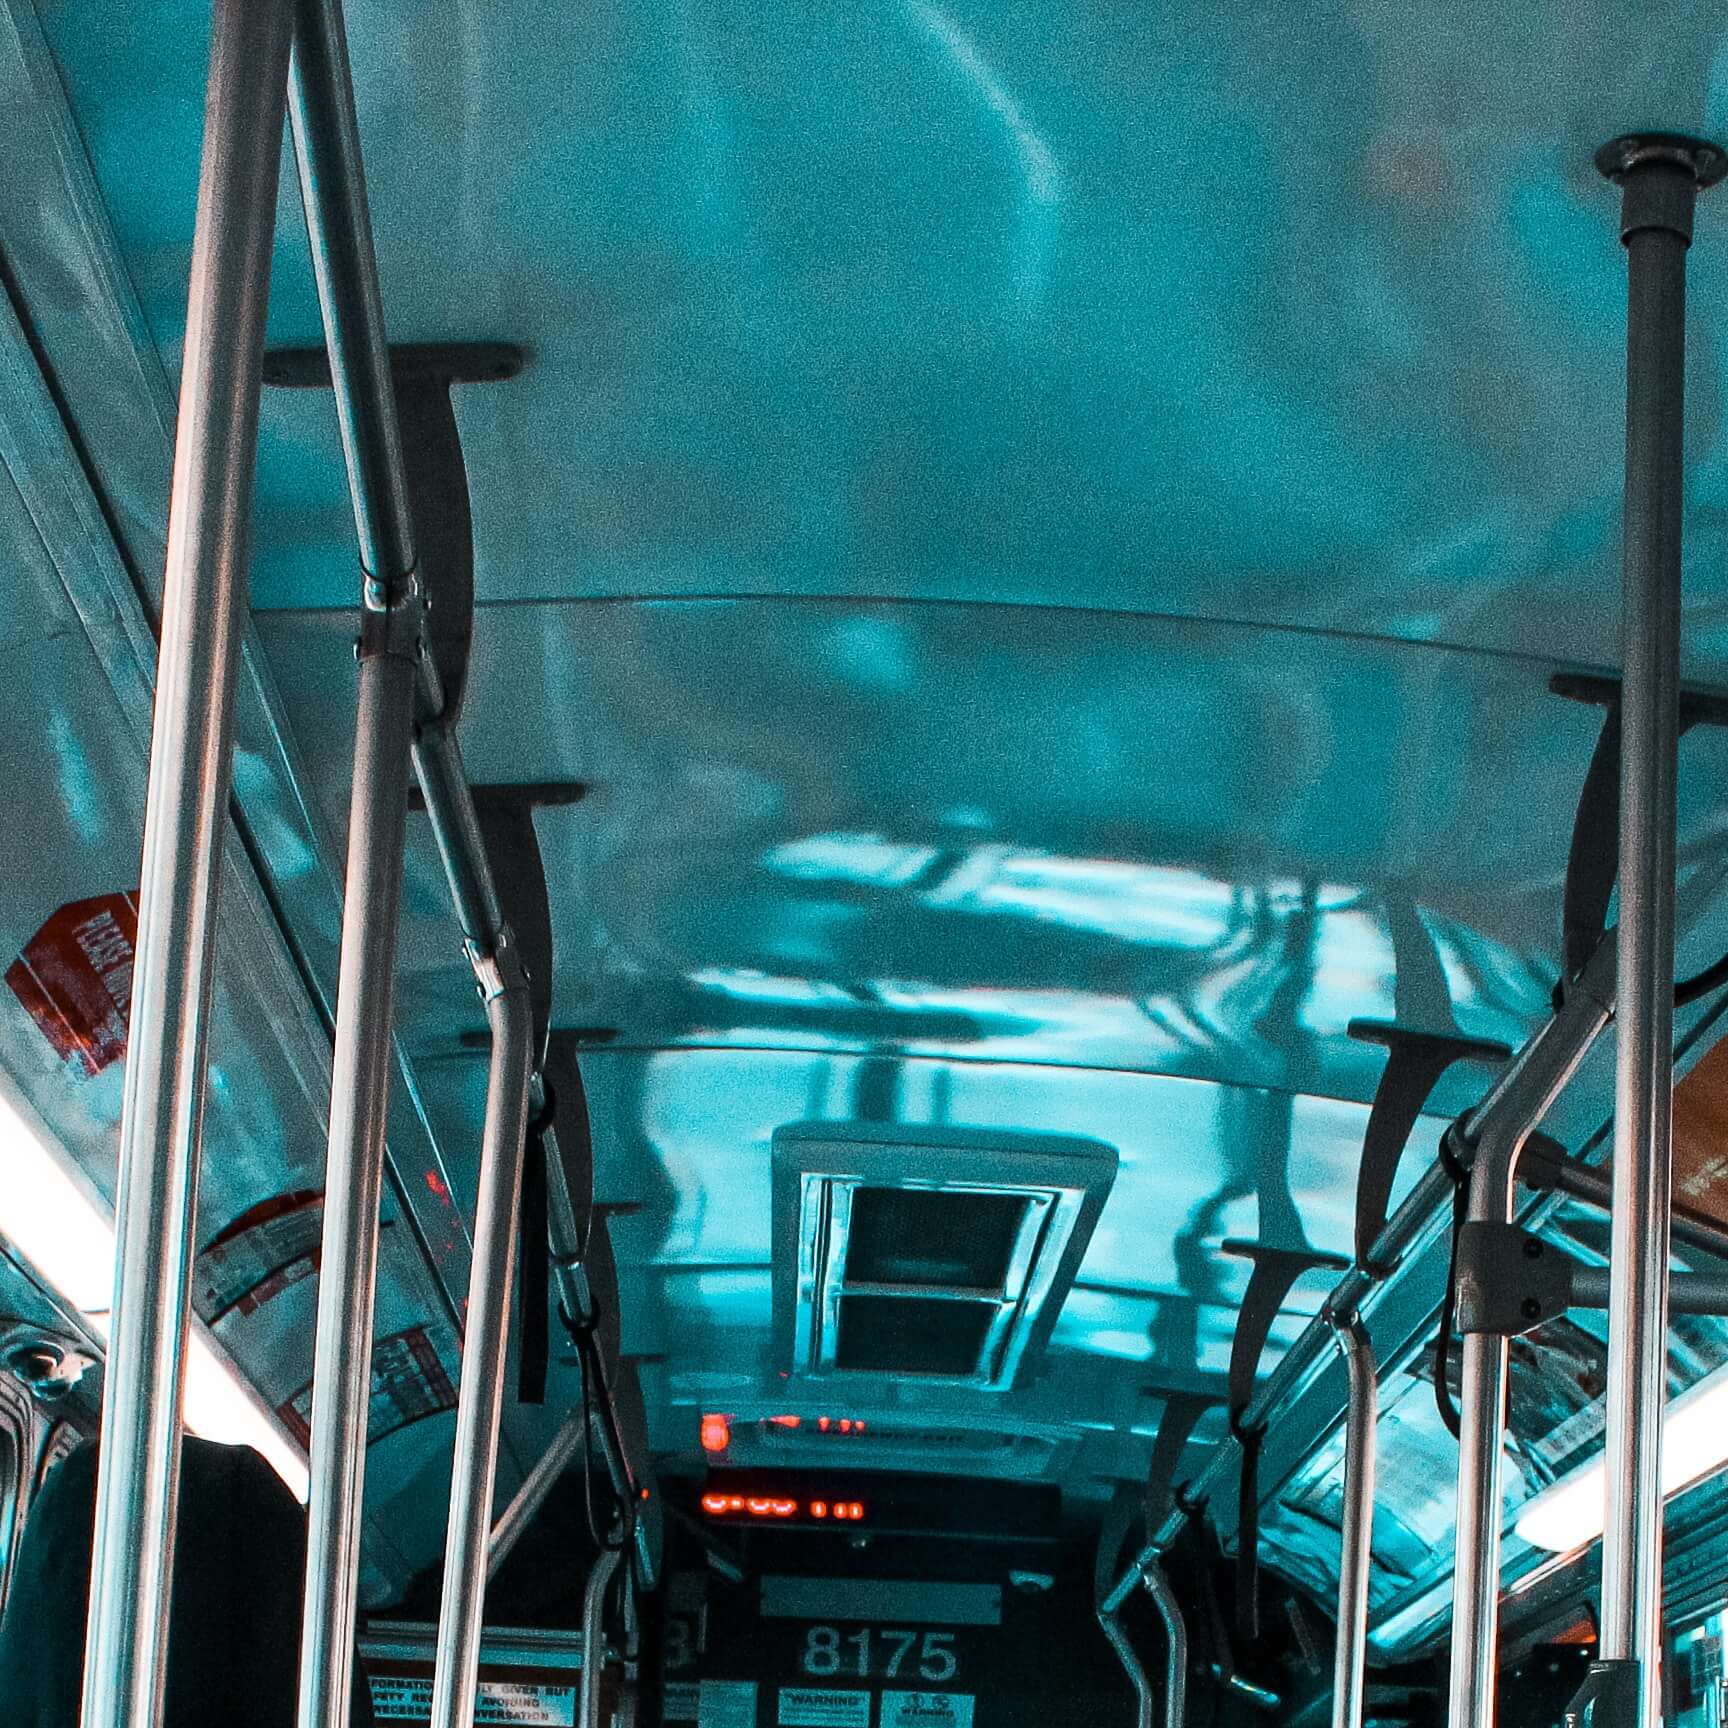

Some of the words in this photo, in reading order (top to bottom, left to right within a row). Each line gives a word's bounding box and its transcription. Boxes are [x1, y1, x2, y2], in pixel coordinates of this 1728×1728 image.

[803, 1626, 957, 1681] 8175
[372, 1679, 433, 1690] FORMATIO
[544, 1686, 568, 1697] BUT
[480, 1697, 540, 1708] AVOIDING
[474, 1708, 549, 1720] NVERSATION
